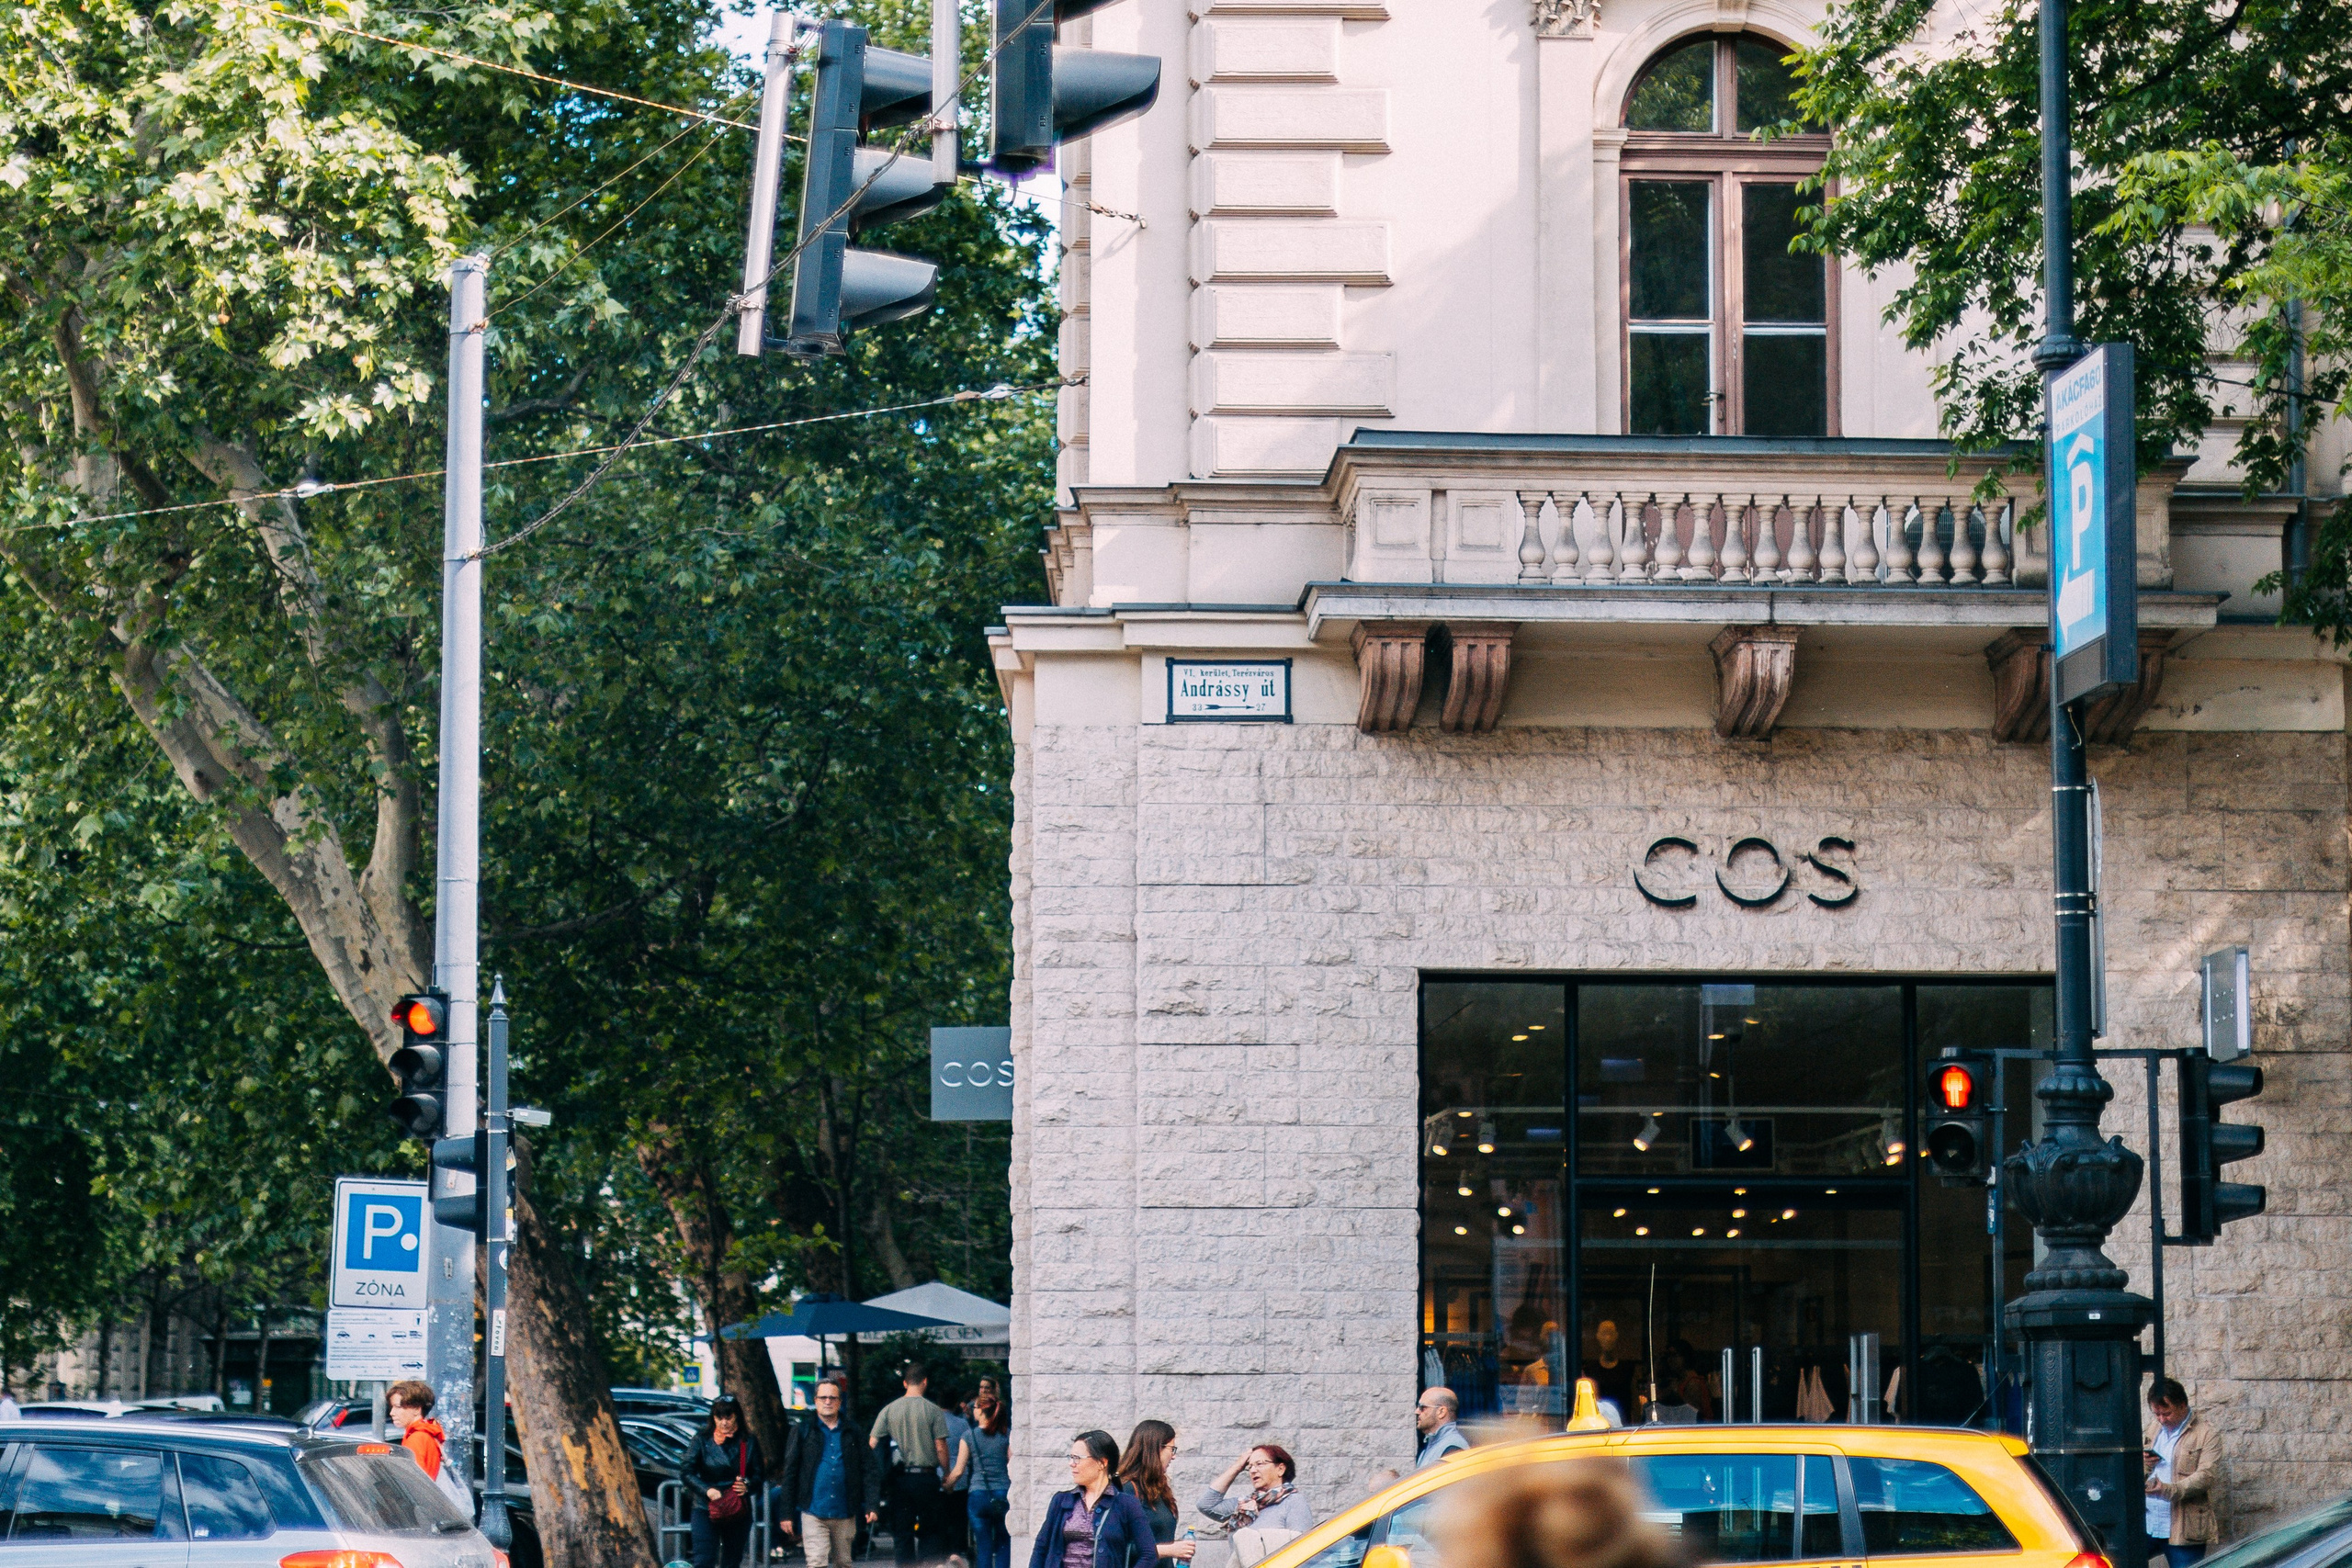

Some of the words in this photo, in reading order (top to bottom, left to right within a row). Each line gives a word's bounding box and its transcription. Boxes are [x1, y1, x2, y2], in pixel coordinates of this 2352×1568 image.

[1232, 668, 1274, 677] Terézváros
[1180, 679, 1250, 703] Andrássy
[1261, 679, 1275, 697] út
[1633, 837, 1859, 908] COS
[940, 1061, 1014, 1088] COS
[355, 1280, 405, 1297] ZÓNA
